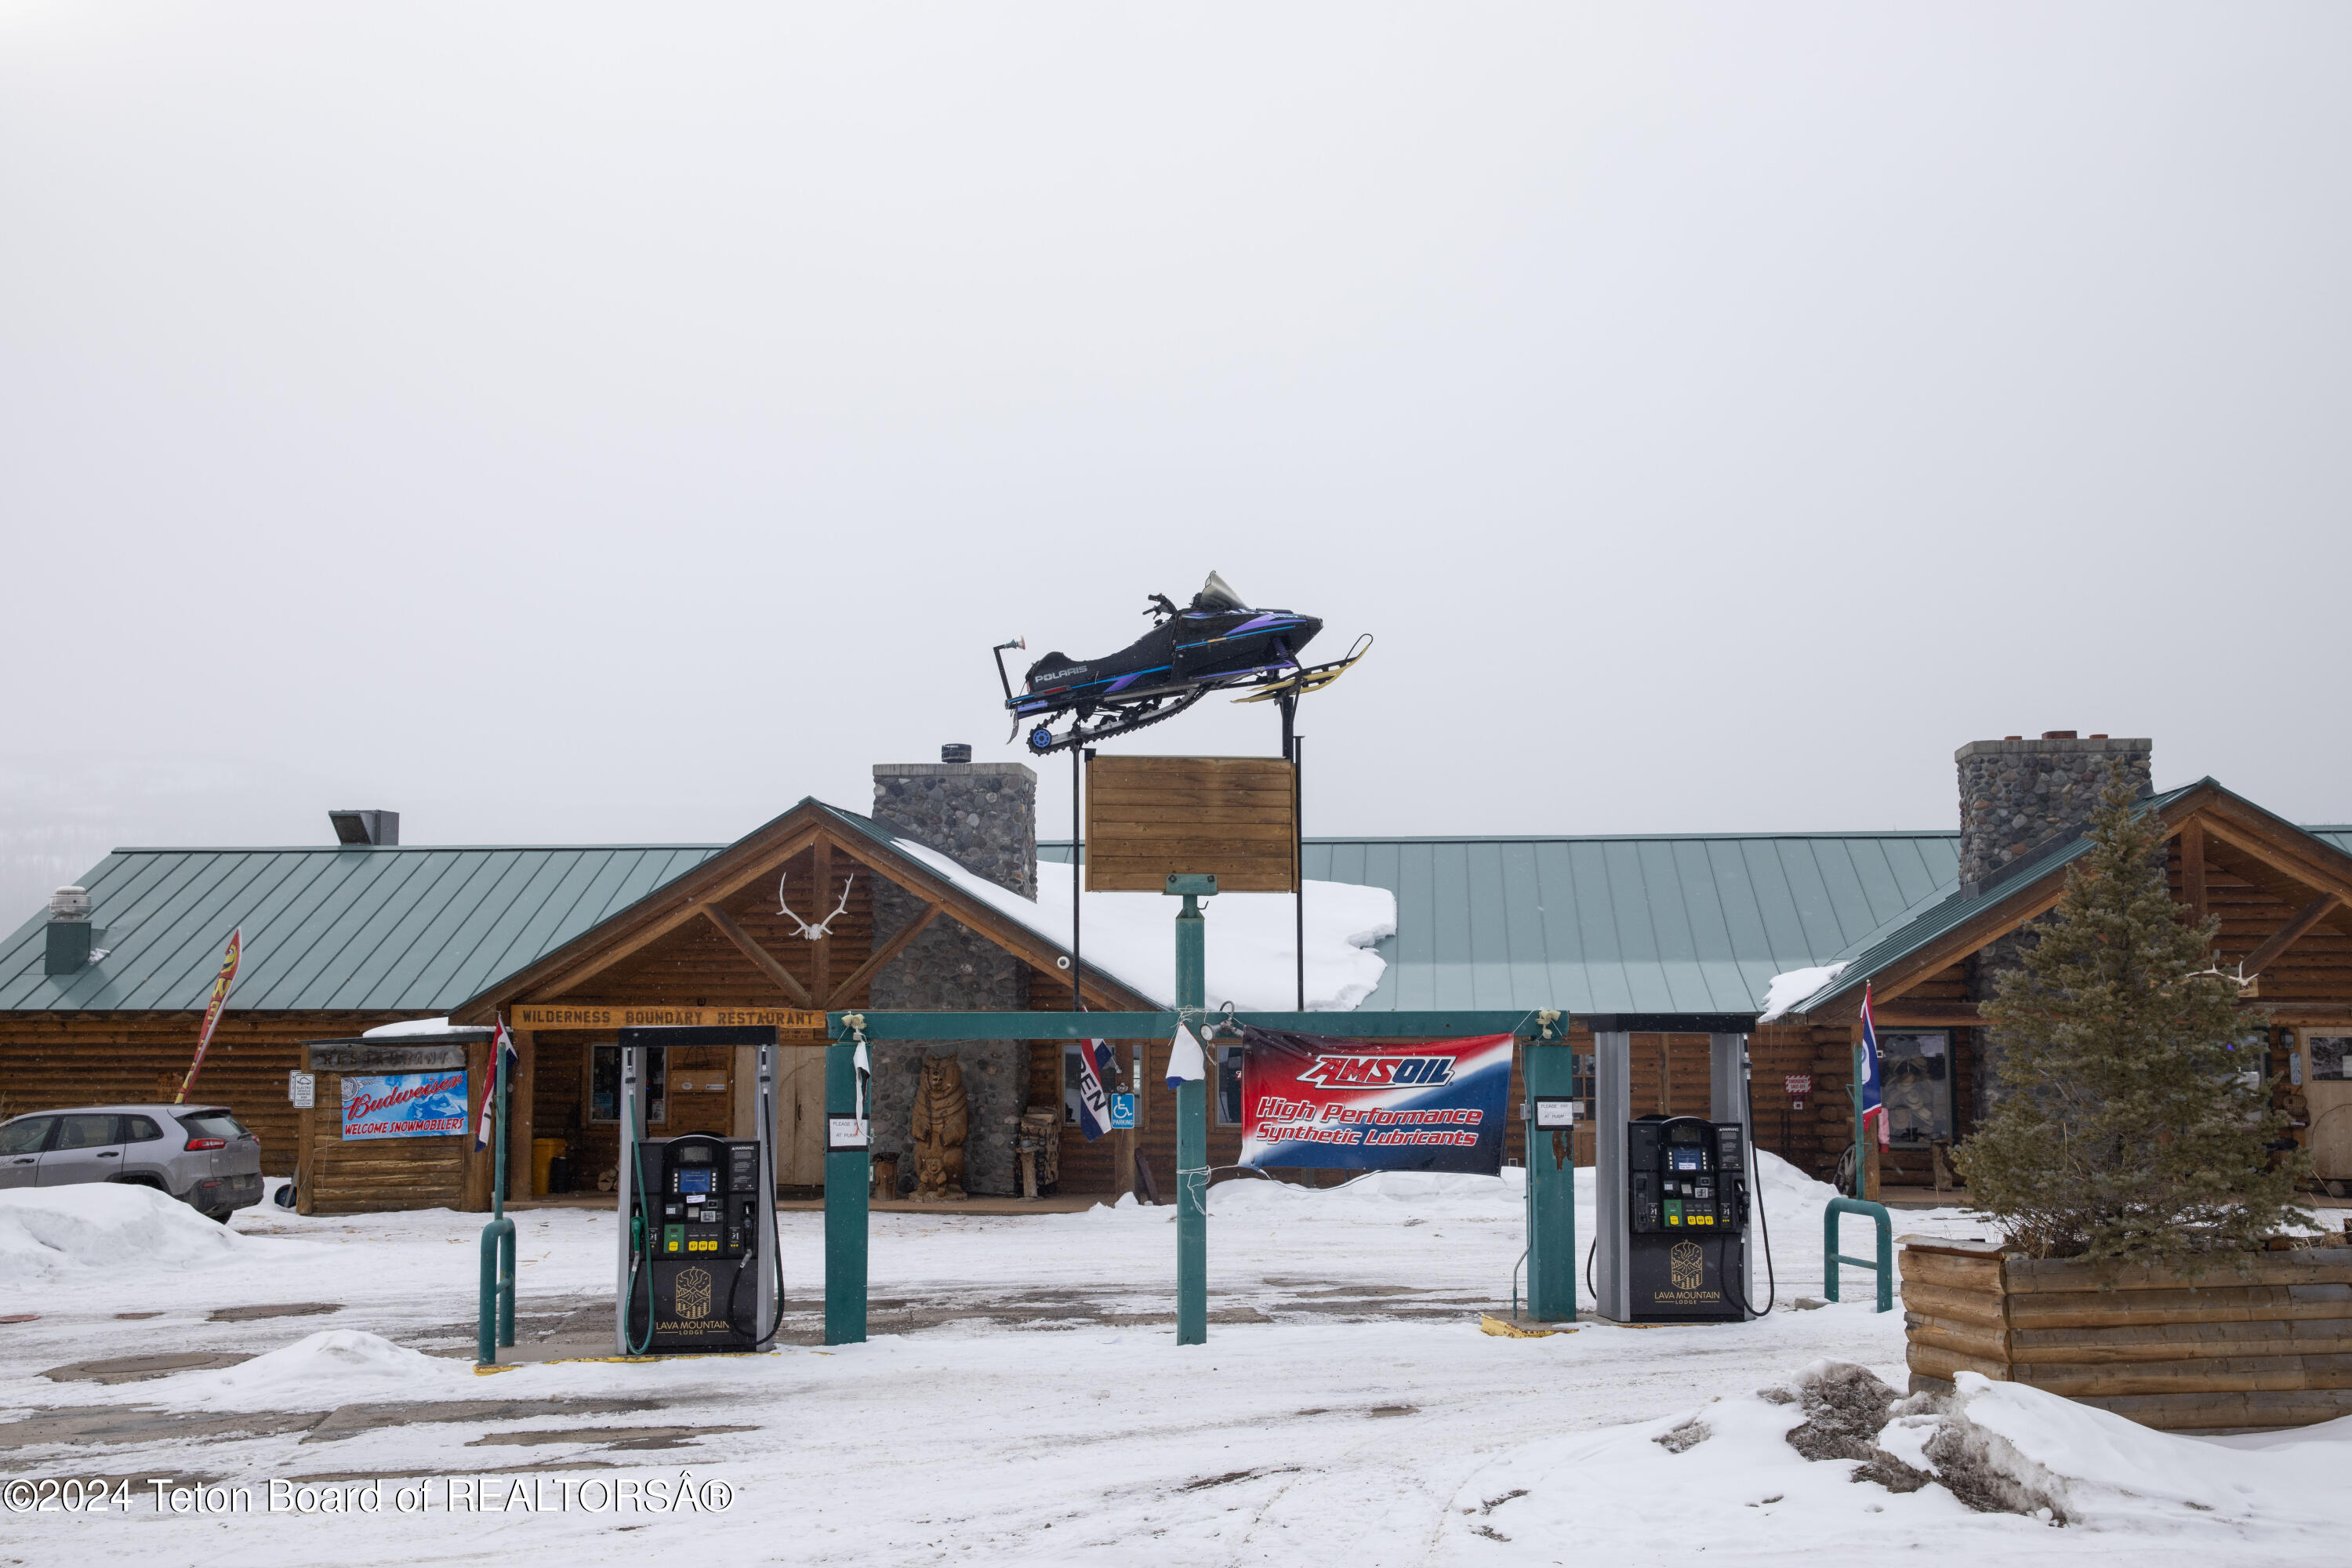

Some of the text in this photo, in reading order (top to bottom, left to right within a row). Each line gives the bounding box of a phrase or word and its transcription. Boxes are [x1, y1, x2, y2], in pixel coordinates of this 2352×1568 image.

[1035, 665, 1088, 683] POLARIS
[523, 1010, 815, 1025] WILDERNESS BOUNDARY RESTAURANT
[1298, 1055, 1455, 1089] AMSOIL
[342, 1073, 463, 1121] Budweiser
[1256, 1097, 1484, 1125] High Performance
[344, 1117, 465, 1135] WELCOME SNOWMOBILERS
[1256, 1123, 1479, 1146] Synthetic Lubricants
[656, 1320, 730, 1330] LAVA MOUNTAIN
